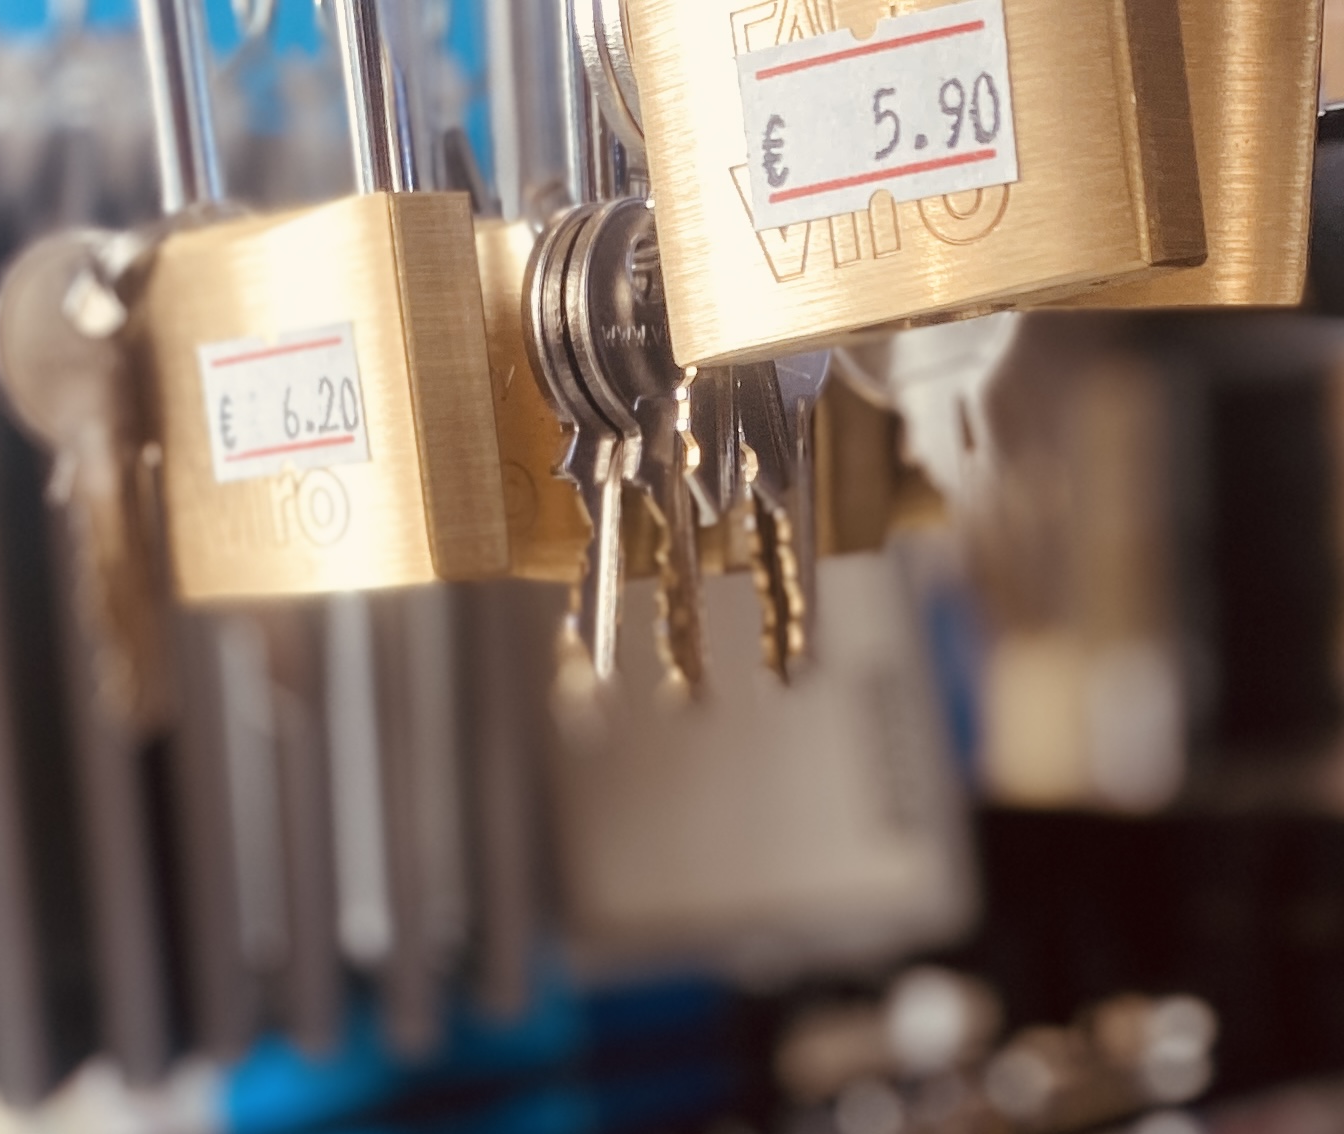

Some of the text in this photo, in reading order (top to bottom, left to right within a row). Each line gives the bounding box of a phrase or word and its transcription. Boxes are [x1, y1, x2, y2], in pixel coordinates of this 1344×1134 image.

[762, 71, 1001, 188] € 5.90
[220, 377, 358, 448] € 6.20
